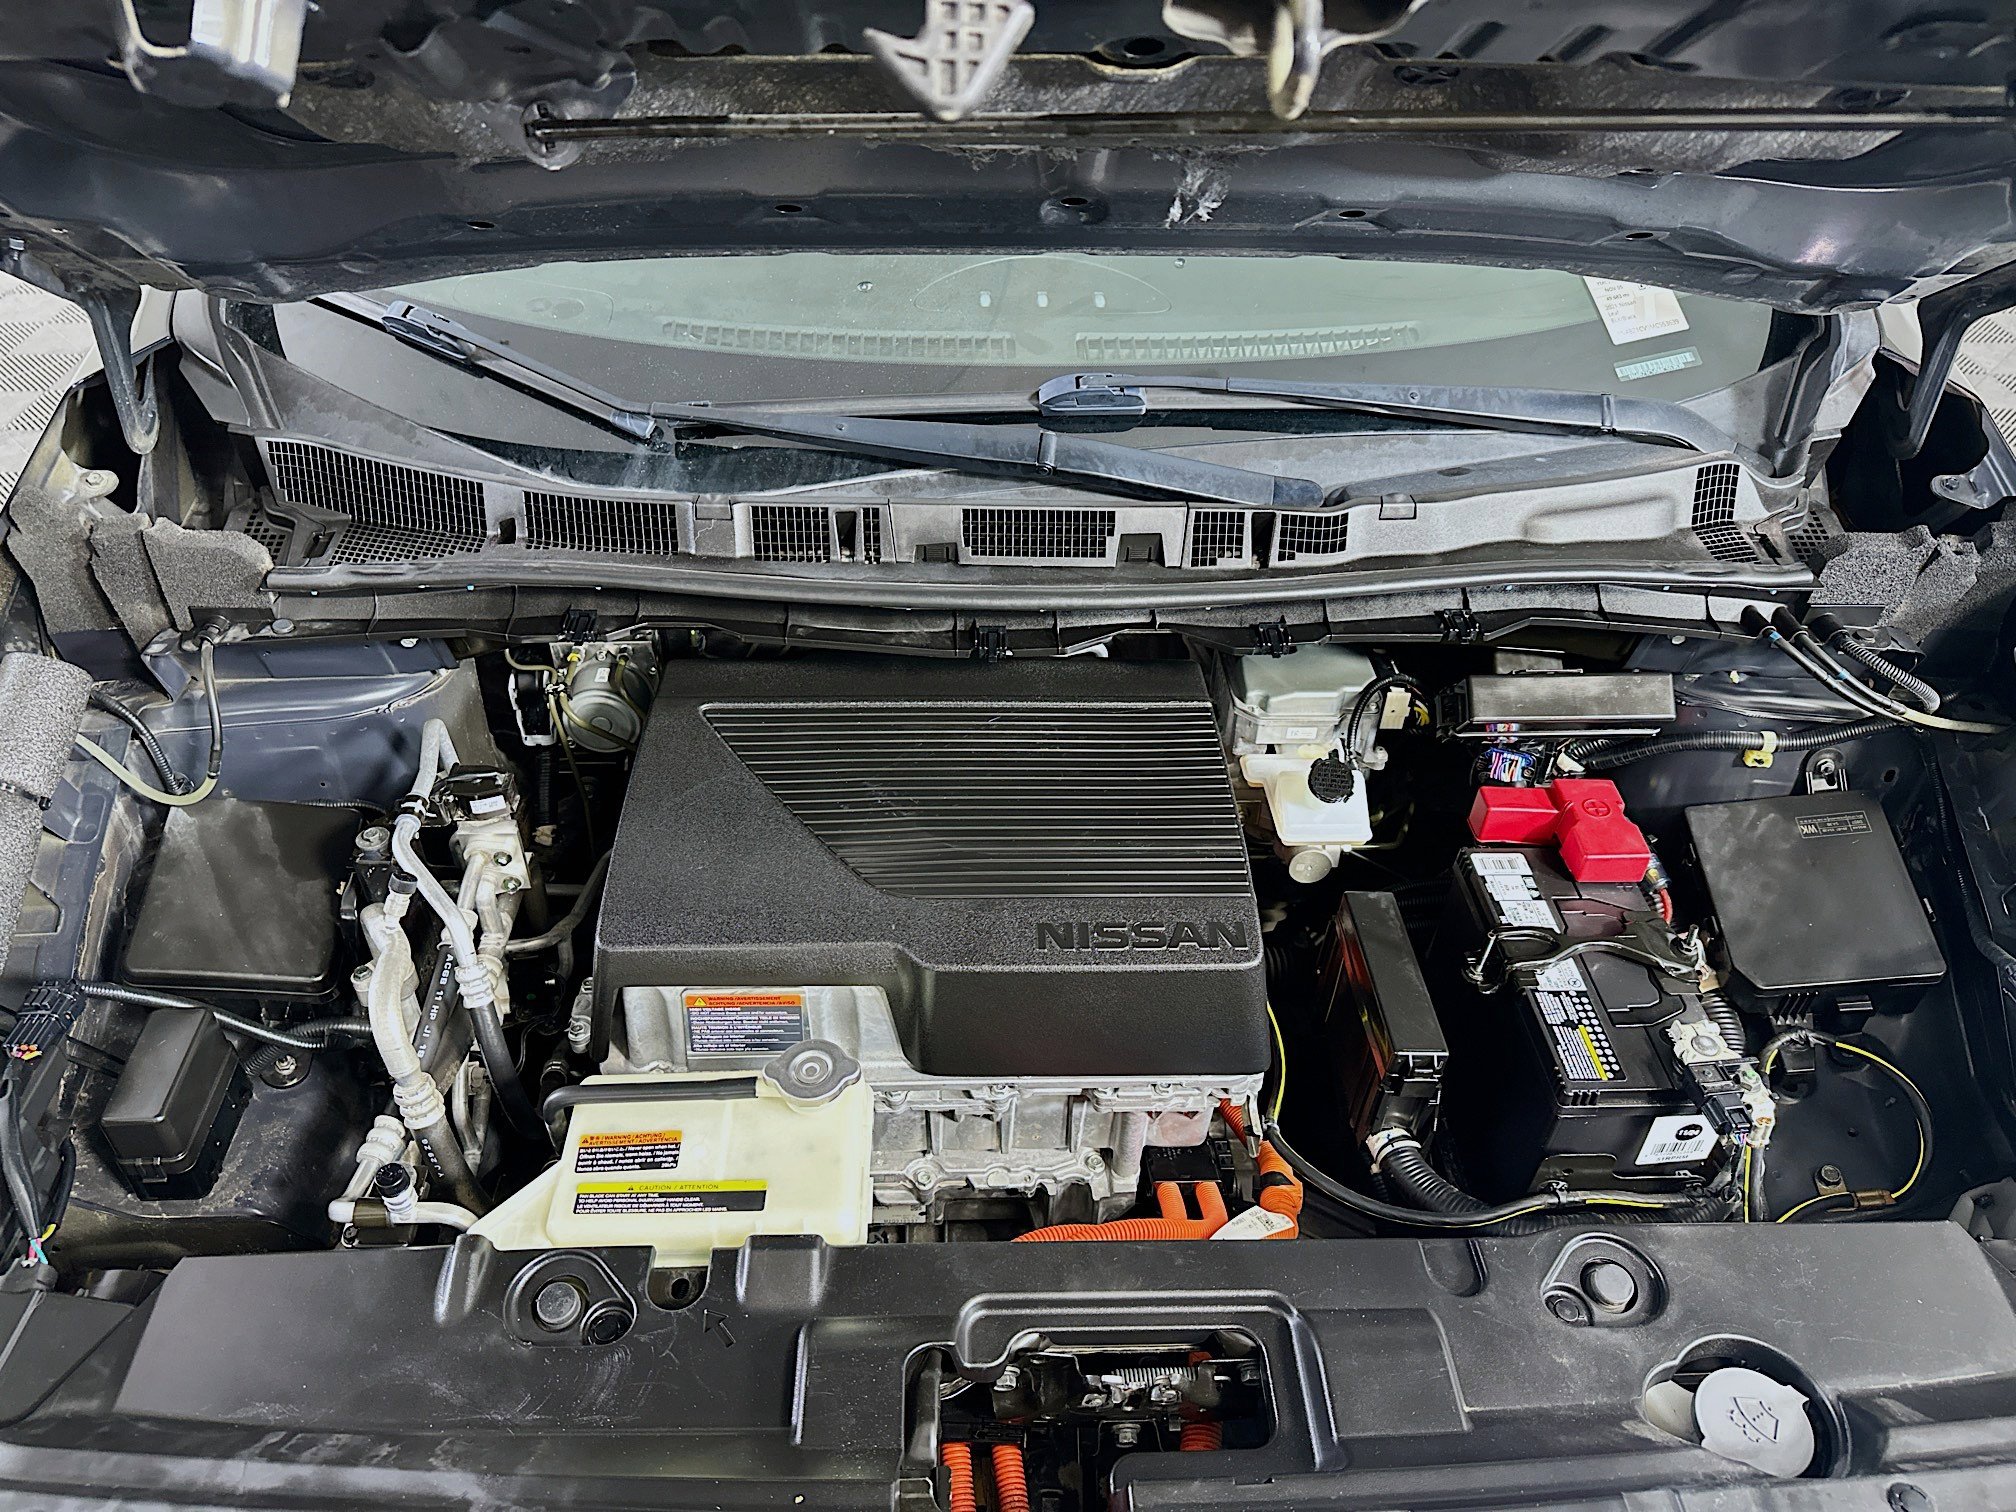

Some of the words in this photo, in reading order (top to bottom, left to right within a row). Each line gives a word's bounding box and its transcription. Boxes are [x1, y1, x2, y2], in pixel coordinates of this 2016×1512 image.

[1800, 824, 1818, 834] WK
[1036, 921, 1250, 951] NISSAN
[429, 1005, 440, 1021] HP
